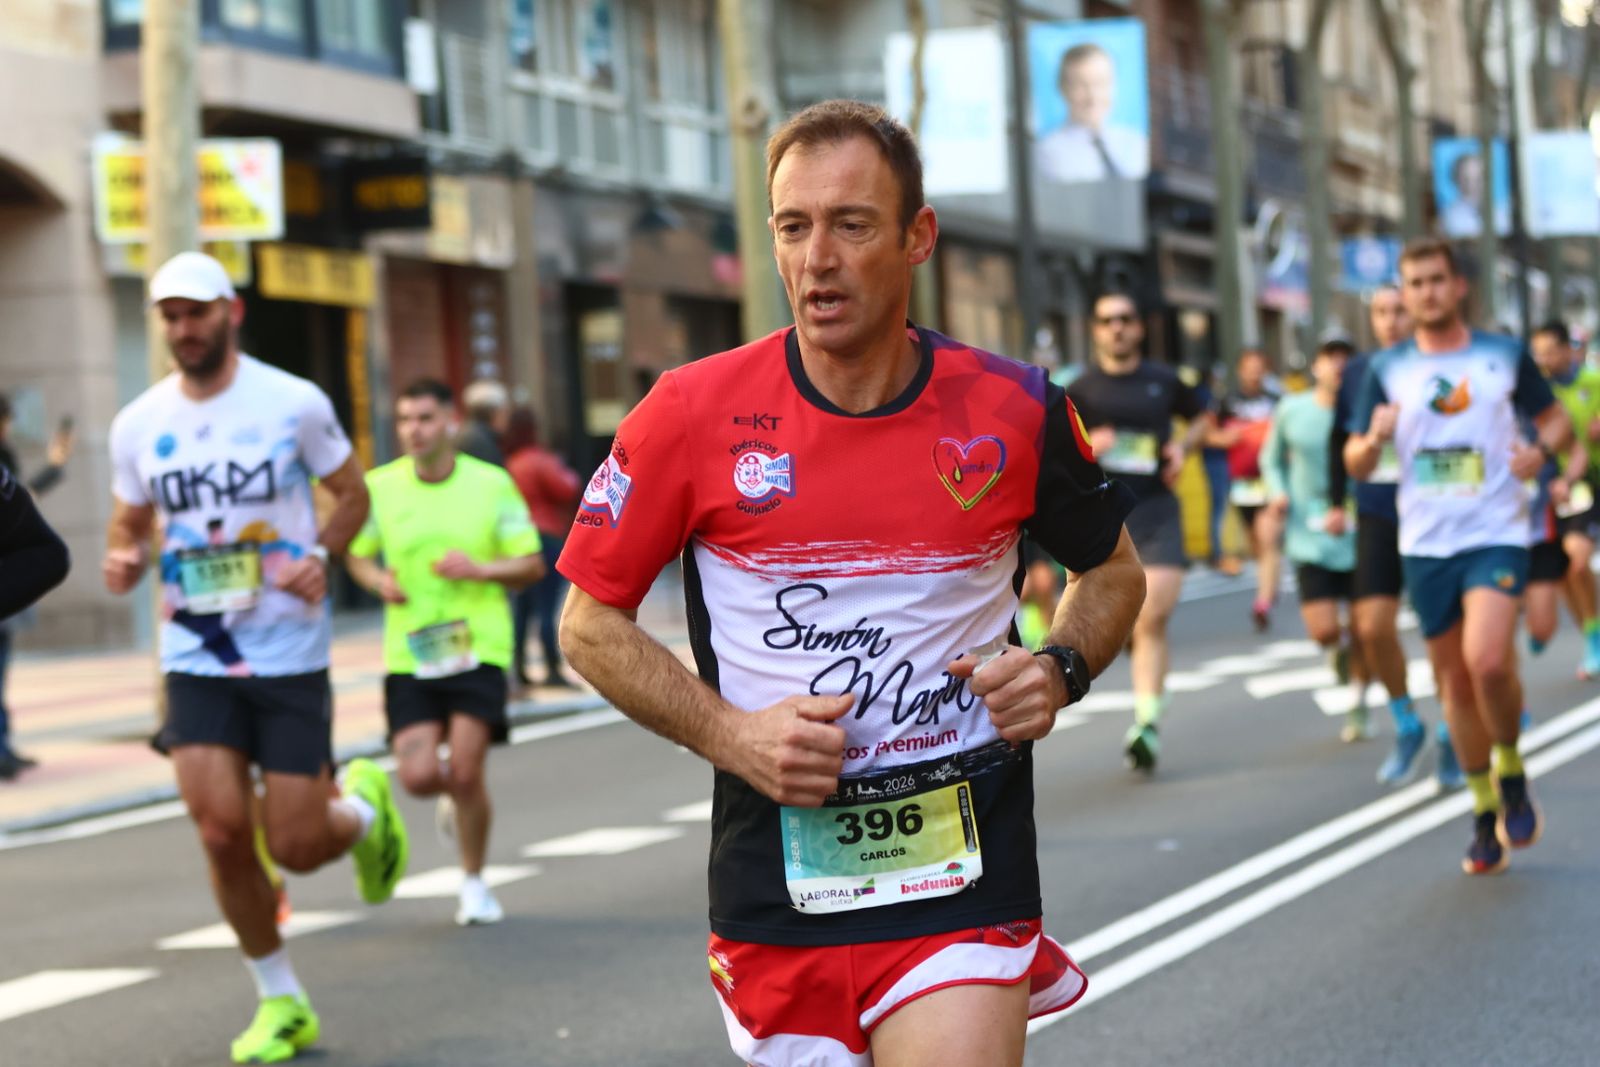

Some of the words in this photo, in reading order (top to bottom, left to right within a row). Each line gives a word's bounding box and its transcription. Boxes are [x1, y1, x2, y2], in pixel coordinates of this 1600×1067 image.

[733, 413, 783, 431] EKT
[729, 439, 778, 456] Ibéricos
[764, 455, 789, 472] SIMON
[764, 474, 789, 490] MARTIN
[735, 497, 782, 516] Guijuelo
[762, 582, 892, 659] Simón
[874, 728, 959, 758] Premium
[883, 774, 916, 793] 2026
[834, 803, 923, 846] 396
[860, 847, 906, 862] CARLOS
[900, 876, 965, 895] bedunia
[800, 889, 852, 902] LABORAL
